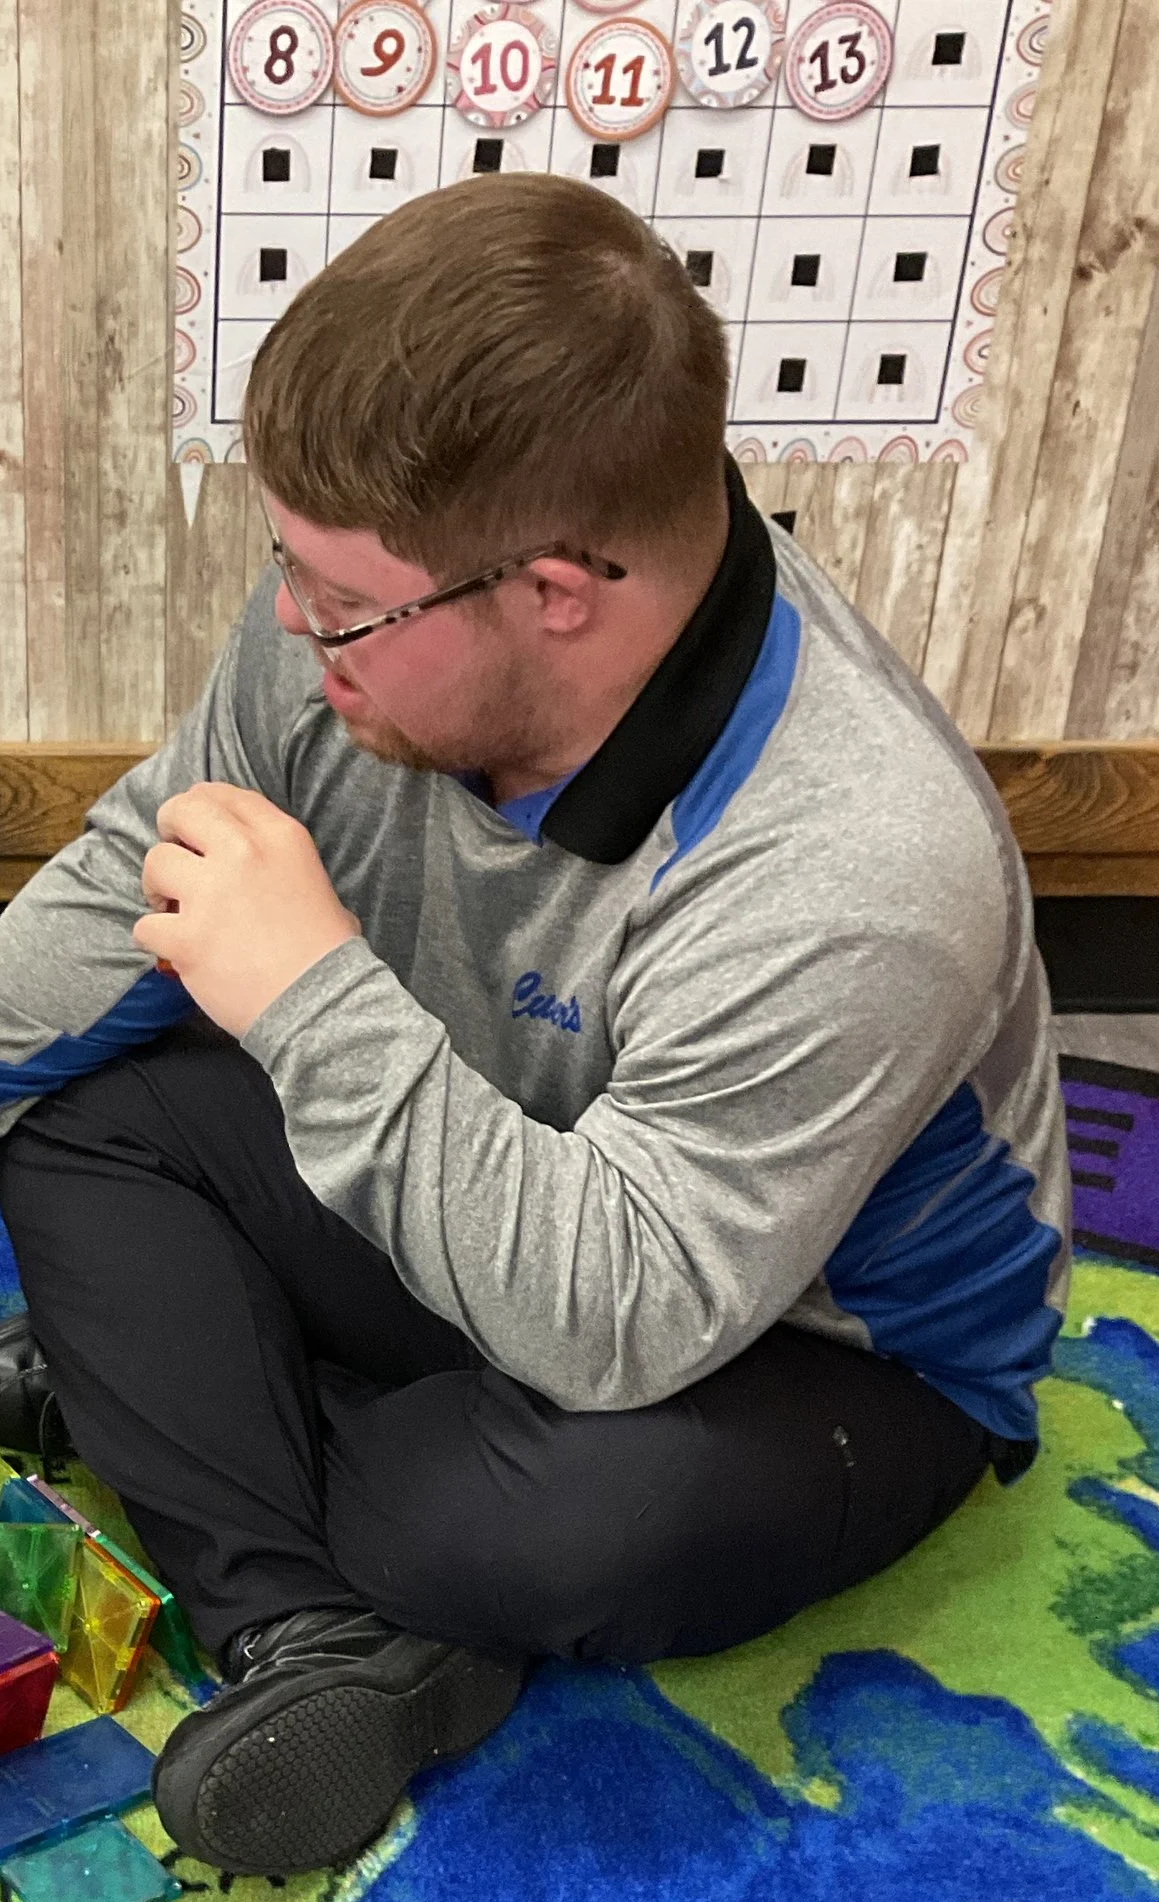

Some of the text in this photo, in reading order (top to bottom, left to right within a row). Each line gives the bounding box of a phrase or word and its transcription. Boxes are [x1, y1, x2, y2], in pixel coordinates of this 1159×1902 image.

[264, 16, 867, 107] 8 9 10 11 12 13
